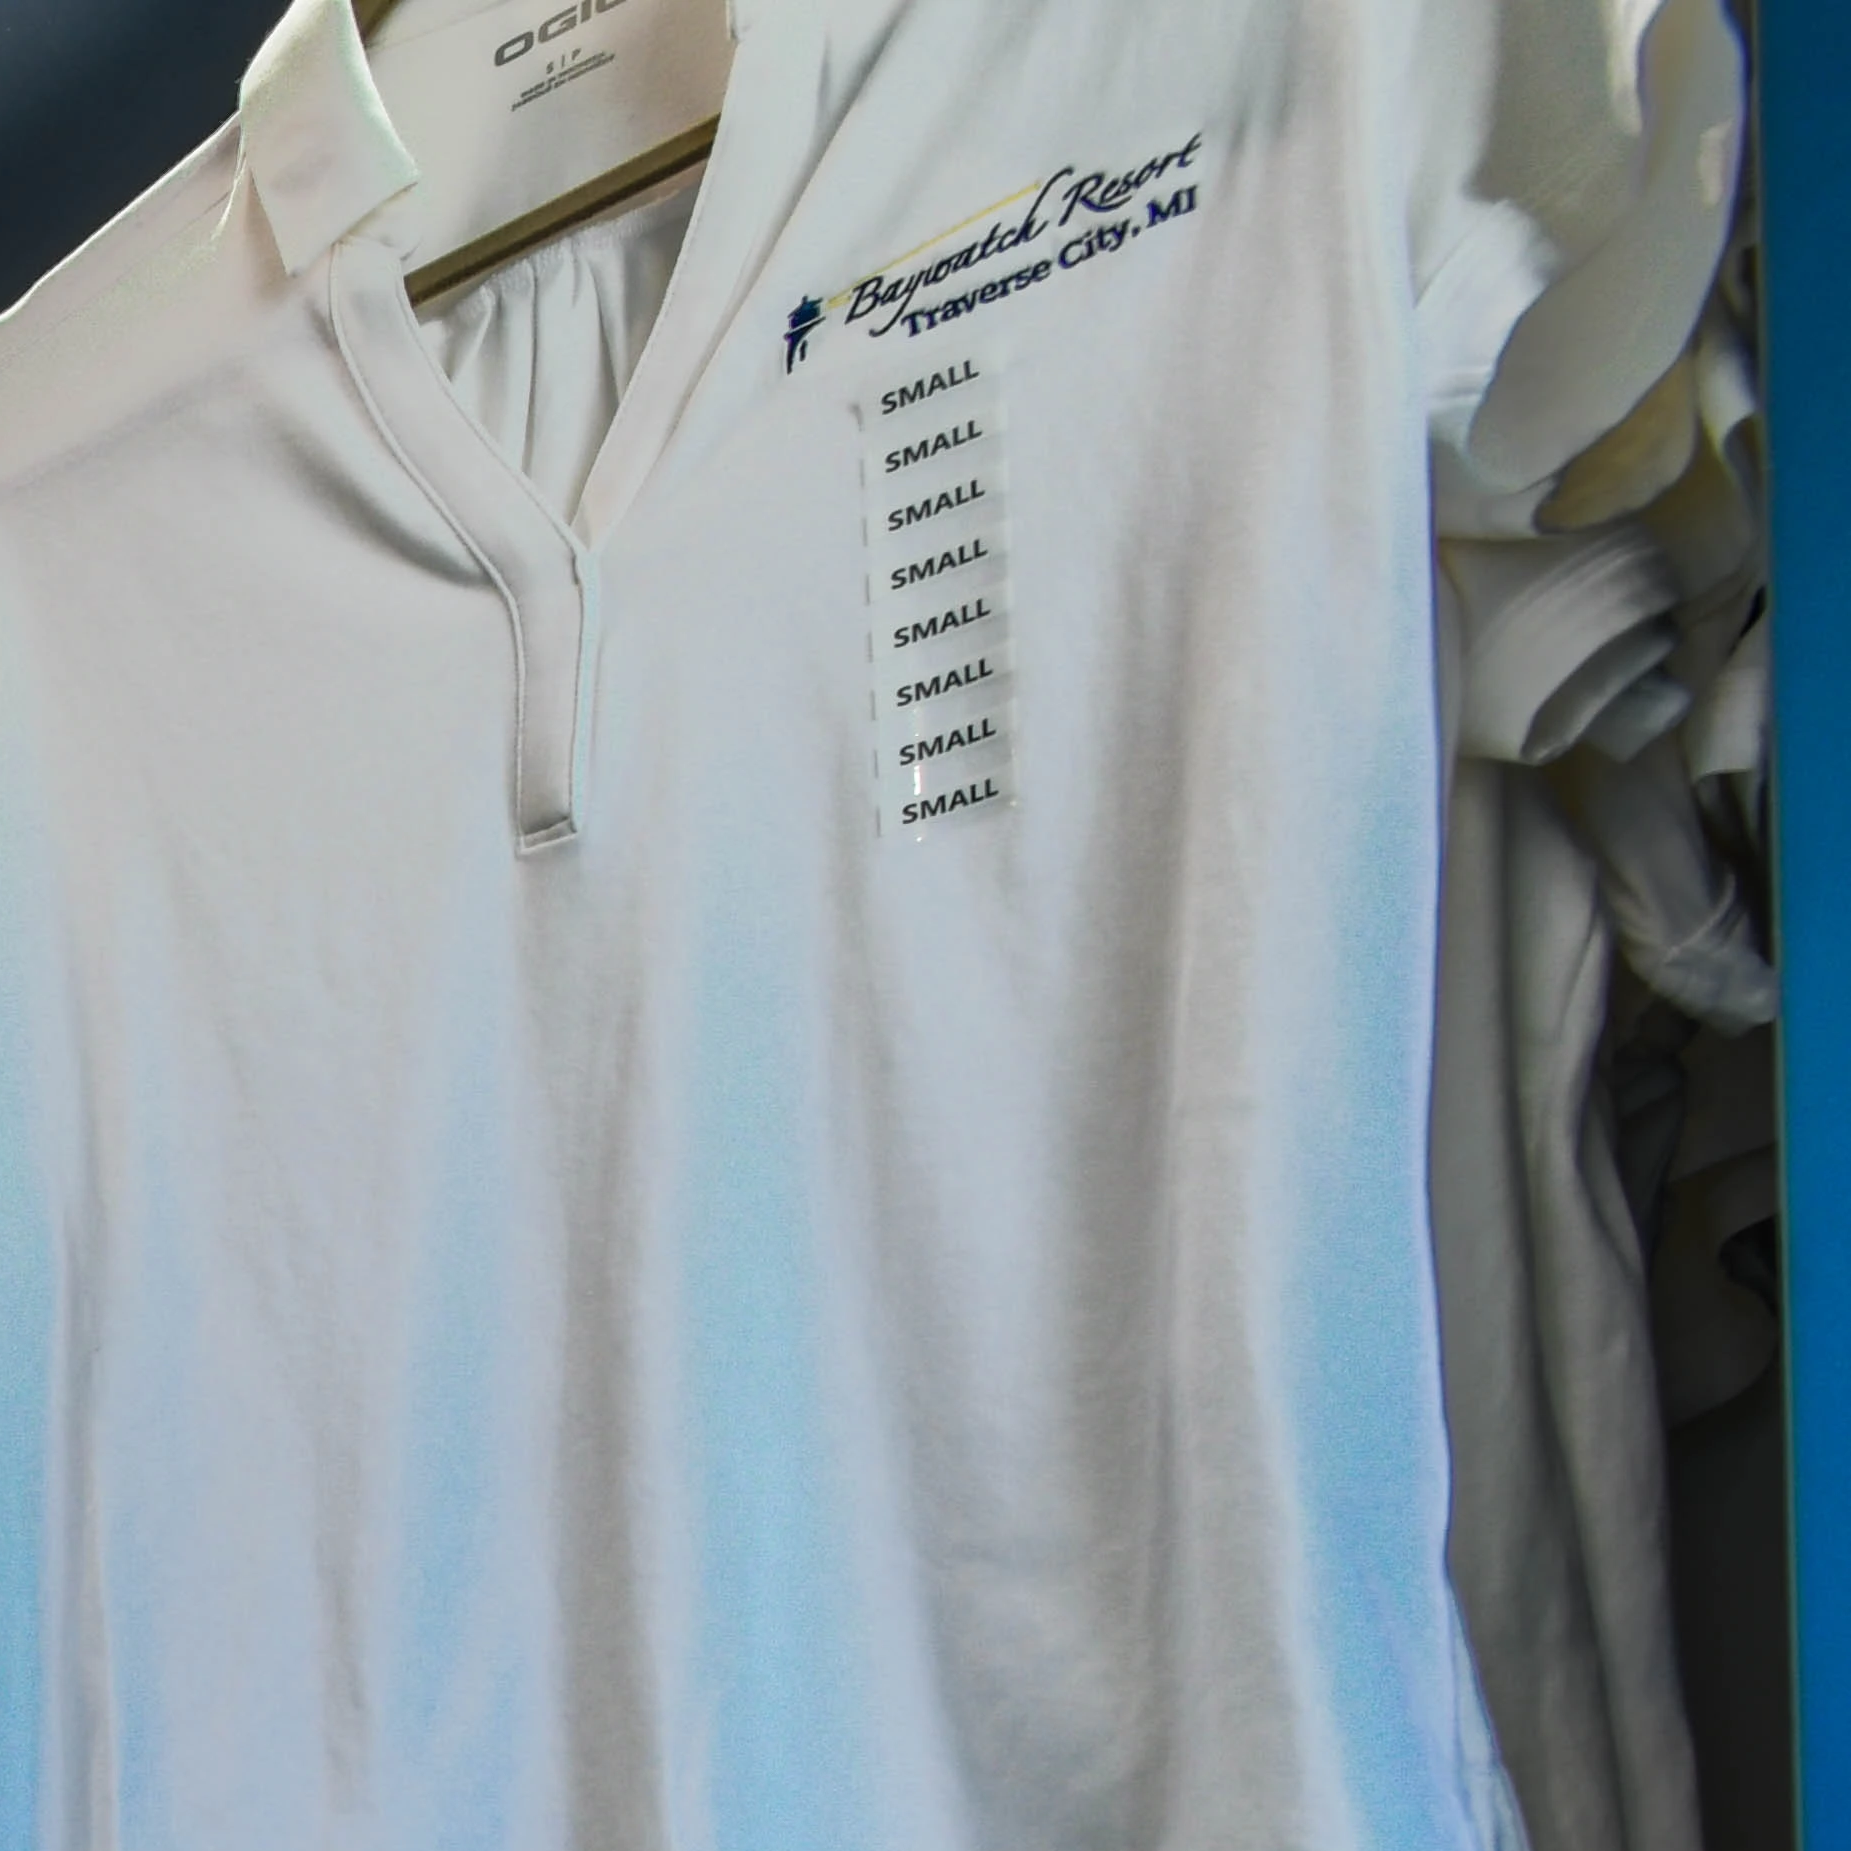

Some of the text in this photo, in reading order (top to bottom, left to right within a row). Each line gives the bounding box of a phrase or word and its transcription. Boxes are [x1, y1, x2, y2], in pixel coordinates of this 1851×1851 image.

[844, 131, 1203, 338] Baywatch Resort
[899, 255, 1052, 338] Traverse
[1146, 184, 1200, 229] MI
[880, 360, 980, 415] SMALL
[884, 419, 983, 473] SMALL
[888, 479, 986, 532] SMALL
[890, 539, 989, 590] SMALL
[894, 598, 991, 648] SMALL
[896, 657, 994, 707] SMALL
[899, 717, 997, 766] SMALL
[902, 777, 999, 825] SMALL
